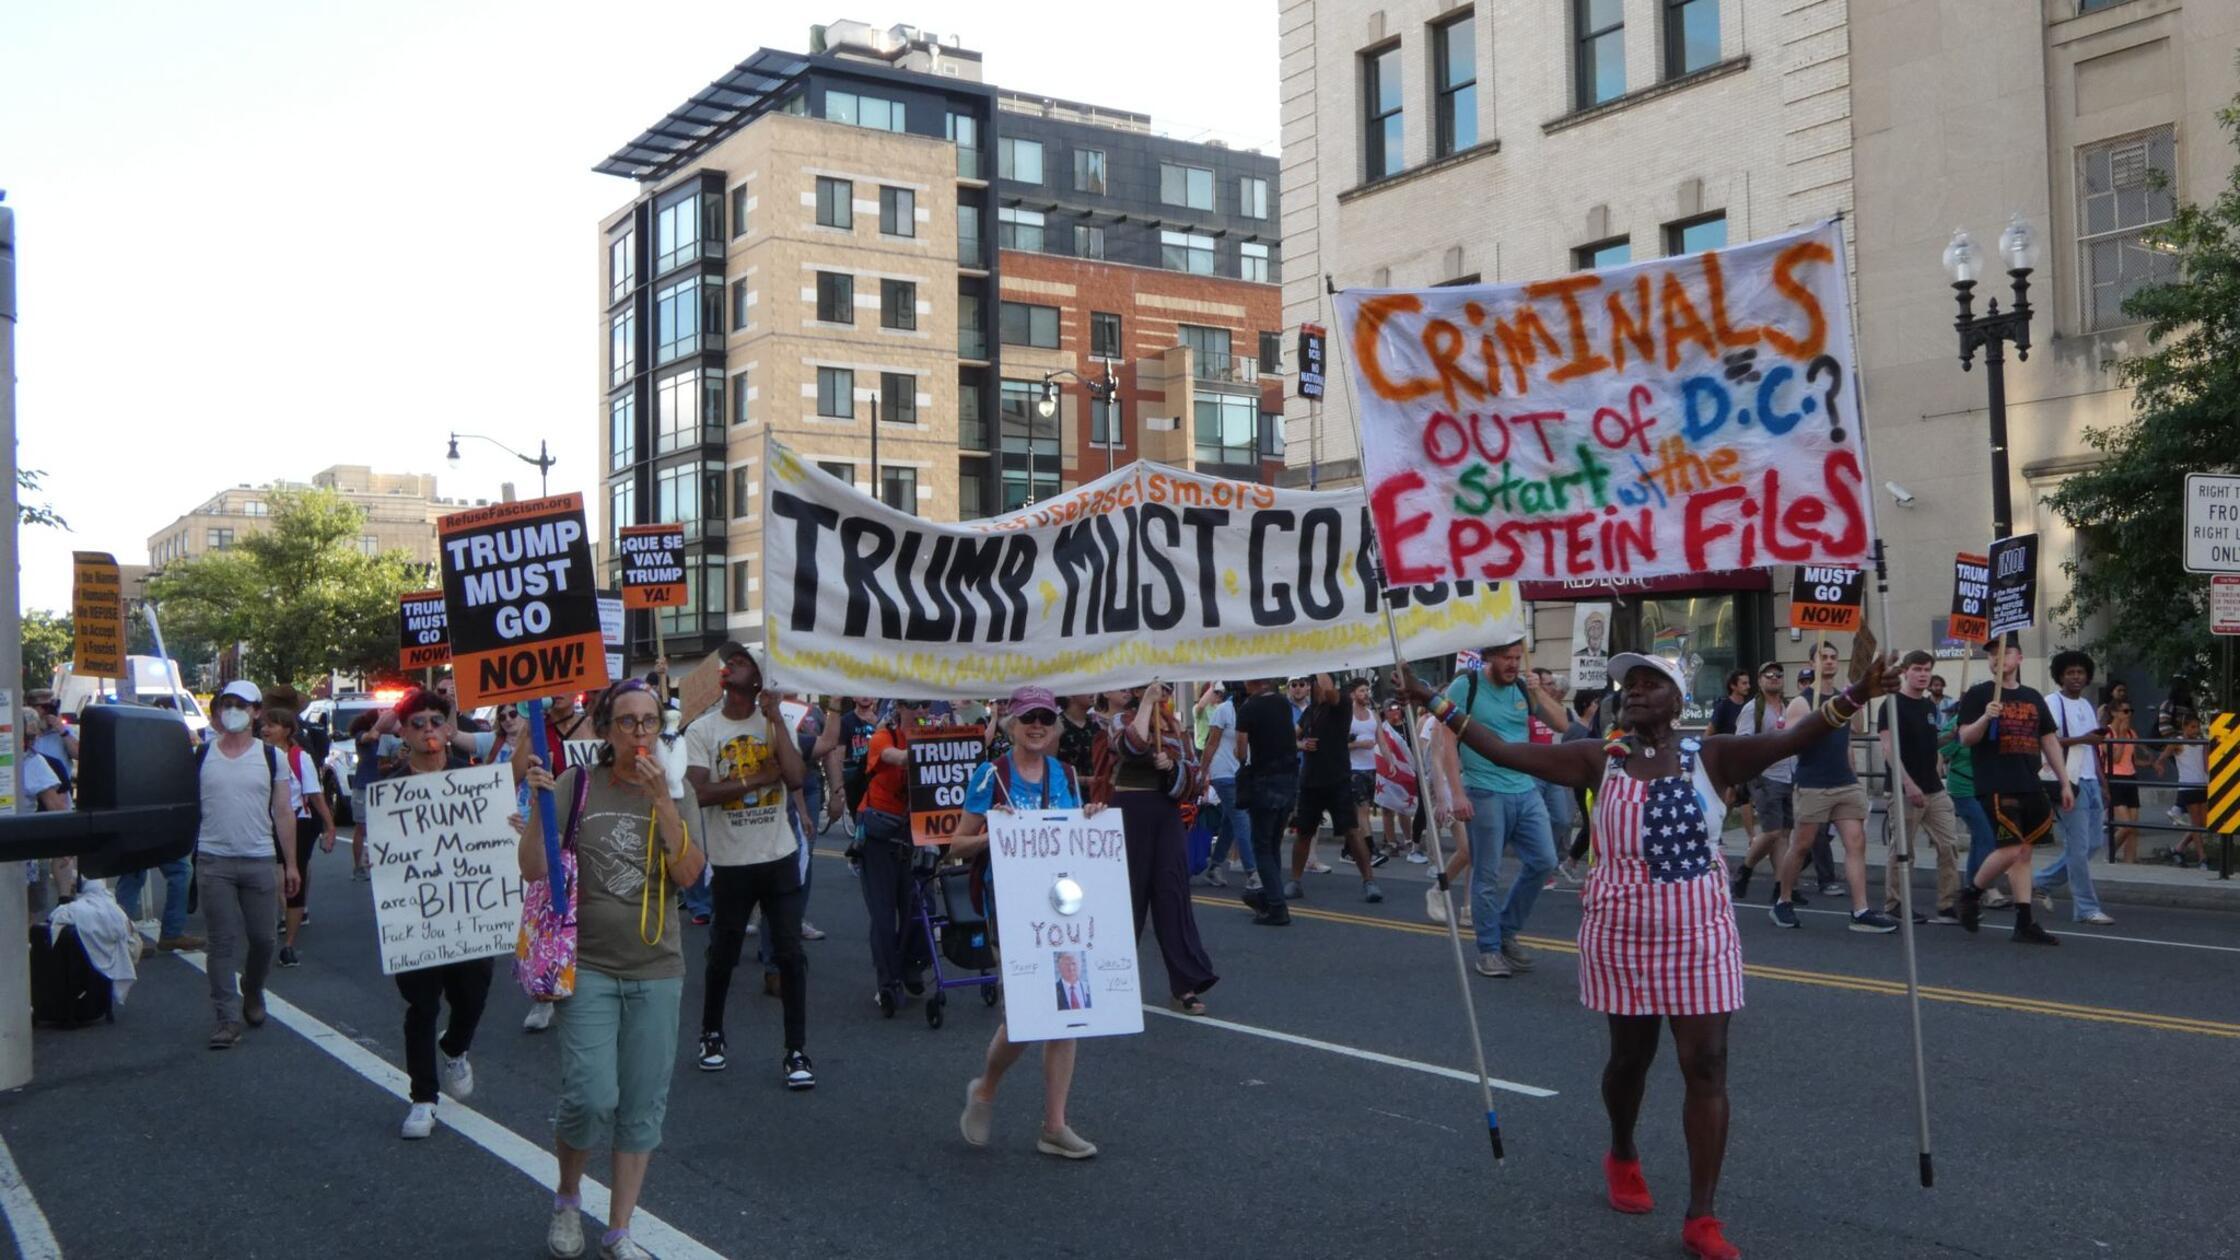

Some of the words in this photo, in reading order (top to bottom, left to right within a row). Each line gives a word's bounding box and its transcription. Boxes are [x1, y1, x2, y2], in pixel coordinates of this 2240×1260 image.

[1424, 411, 1564, 467] OUT
[1648, 436, 1740, 497] the
[2199, 485, 2230, 499] RIGHT
[446, 496, 572, 528] RefuseFascism.org
[2209, 504, 2239, 522] FRO
[2194, 525, 2230, 540] RIGHT
[446, 520, 581, 572] TRUMP
[622, 536, 660, 555] ¡QUE
[663, 535, 683, 550] SE
[2211, 545, 2240, 563] ONL
[633, 552, 674, 567] VAYA
[772, 490, 1037, 644] TRUMP
[1051, 501, 1230, 640] MUST
[1250, 506, 1347, 630] GO
[464, 558, 572, 608] MUST
[626, 567, 683, 584] TRUMP
[1804, 567, 1856, 585] MUST
[1957, 564, 1989, 583] TRUM
[643, 587, 671, 603] YA!
[1815, 585, 1842, 602] GO
[403, 600, 446, 616] TRUM
[1802, 606, 1853, 624] NOW!
[1962, 598, 1979, 615] GO
[408, 613, 448, 631] MUST
[496, 601, 551, 640] GO
[1956, 619, 1986, 636] NOW!
[418, 629, 441, 645] GO
[480, 642, 585, 692] NOW!
[911, 741, 983, 763] TRUMP
[920, 763, 977, 785] MUST
[368, 783, 388, 807] IF
[393, 780, 431, 803] You
[442, 771, 504, 799] Support
[935, 786, 966, 807] GO
[387, 797, 489, 837] TRUMP
[726, 811, 744, 819] THE
[731, 815, 775, 827] NETWORK
[925, 813, 961, 836] NO
[373, 842, 423, 866] Your
[433, 832, 516, 857] Momma
[996, 826, 1062, 858] WHO'S
[1069, 828, 1124, 862] NEXT?
[404, 862, 444, 883] And
[453, 856, 492, 877] You
[381, 896, 408, 911] are
[409, 896, 420, 906] a
[418, 875, 525, 919] BITCH
[421, 921, 446, 940] You
[468, 915, 515, 934] Trump
[1031, 916, 1094, 950] YOU!
